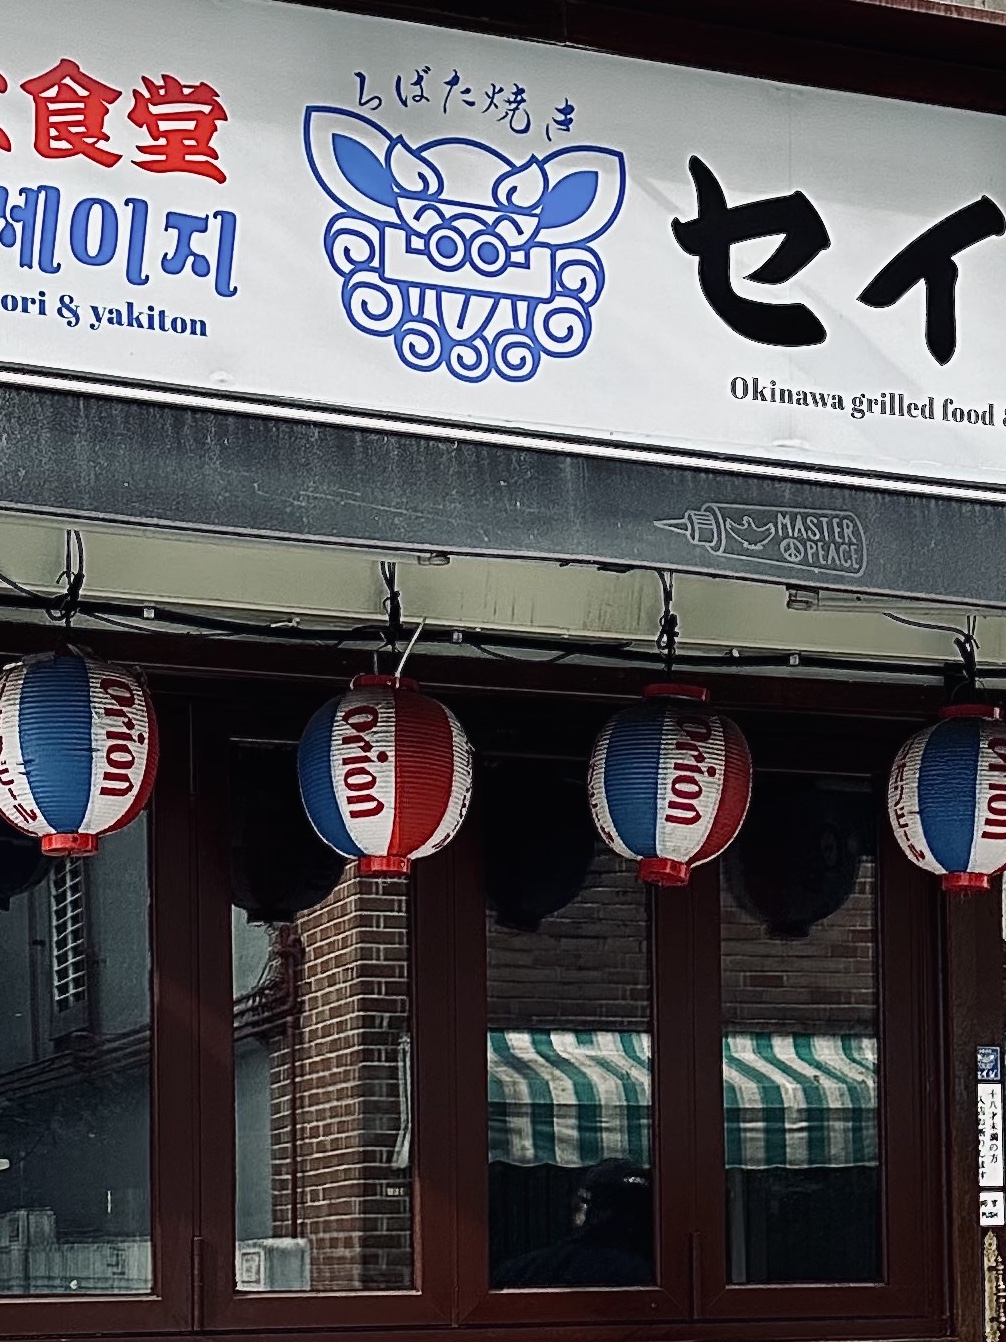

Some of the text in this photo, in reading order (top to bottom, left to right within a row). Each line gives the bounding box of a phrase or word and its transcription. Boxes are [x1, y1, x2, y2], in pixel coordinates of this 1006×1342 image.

[0, 58, 228, 184] 食堂
[89, 302, 208, 337] yakiton
[730, 376, 845, 411] Okinawa
[850, 391, 935, 420] grilled
[941, 397, 995, 427] food
[776, 512, 858, 544] MASTER
[806, 541, 861, 569] PEACE
